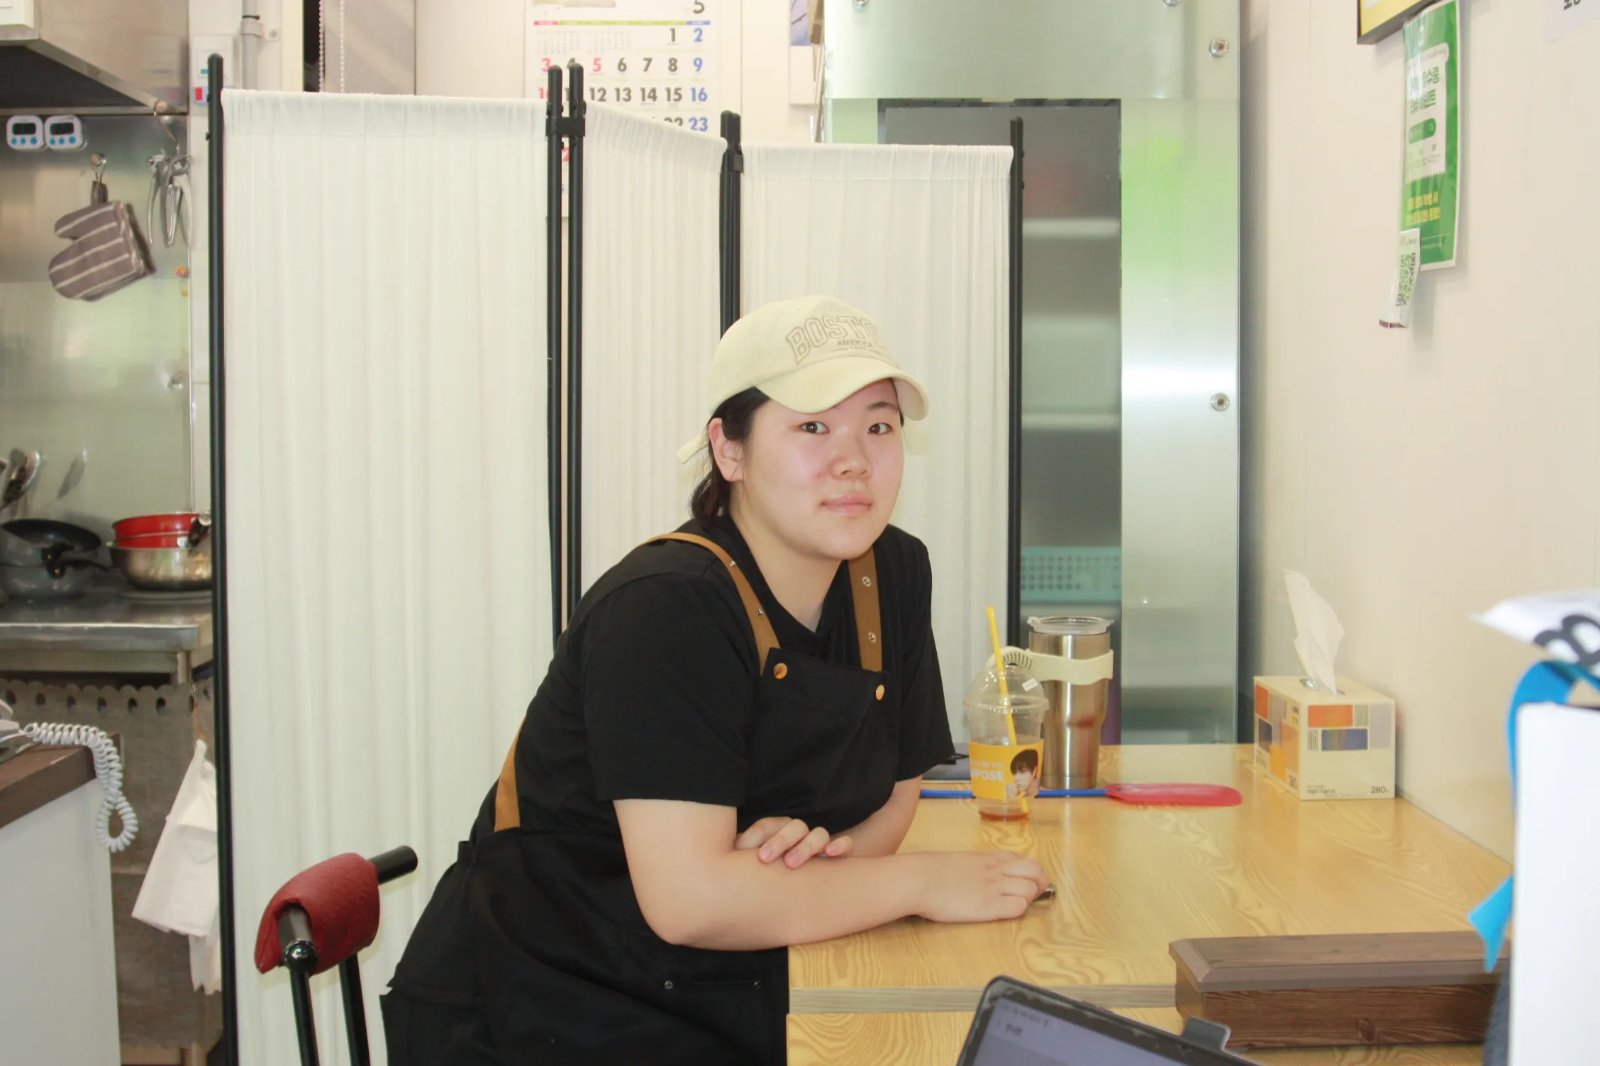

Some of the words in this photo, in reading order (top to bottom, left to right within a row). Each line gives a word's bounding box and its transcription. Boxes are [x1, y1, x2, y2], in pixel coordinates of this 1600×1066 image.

[692, 0, 705, 14] 5
[669, 27, 676, 42] 1
[693, 27, 703, 42] 2
[541, 57, 551, 72] 3
[592, 57, 602, 72] 5
[617, 57, 627, 72] 6
[642, 57, 653, 72] 7
[668, 57, 678, 72] 8
[693, 57, 703, 72] 9
[589, 87, 607, 102] 12
[615, 87, 632, 102] 13
[640, 87, 657, 102] 14
[665, 87, 682, 102] 15
[690, 87, 708, 102] 16
[688, 117, 708, 132] 23
